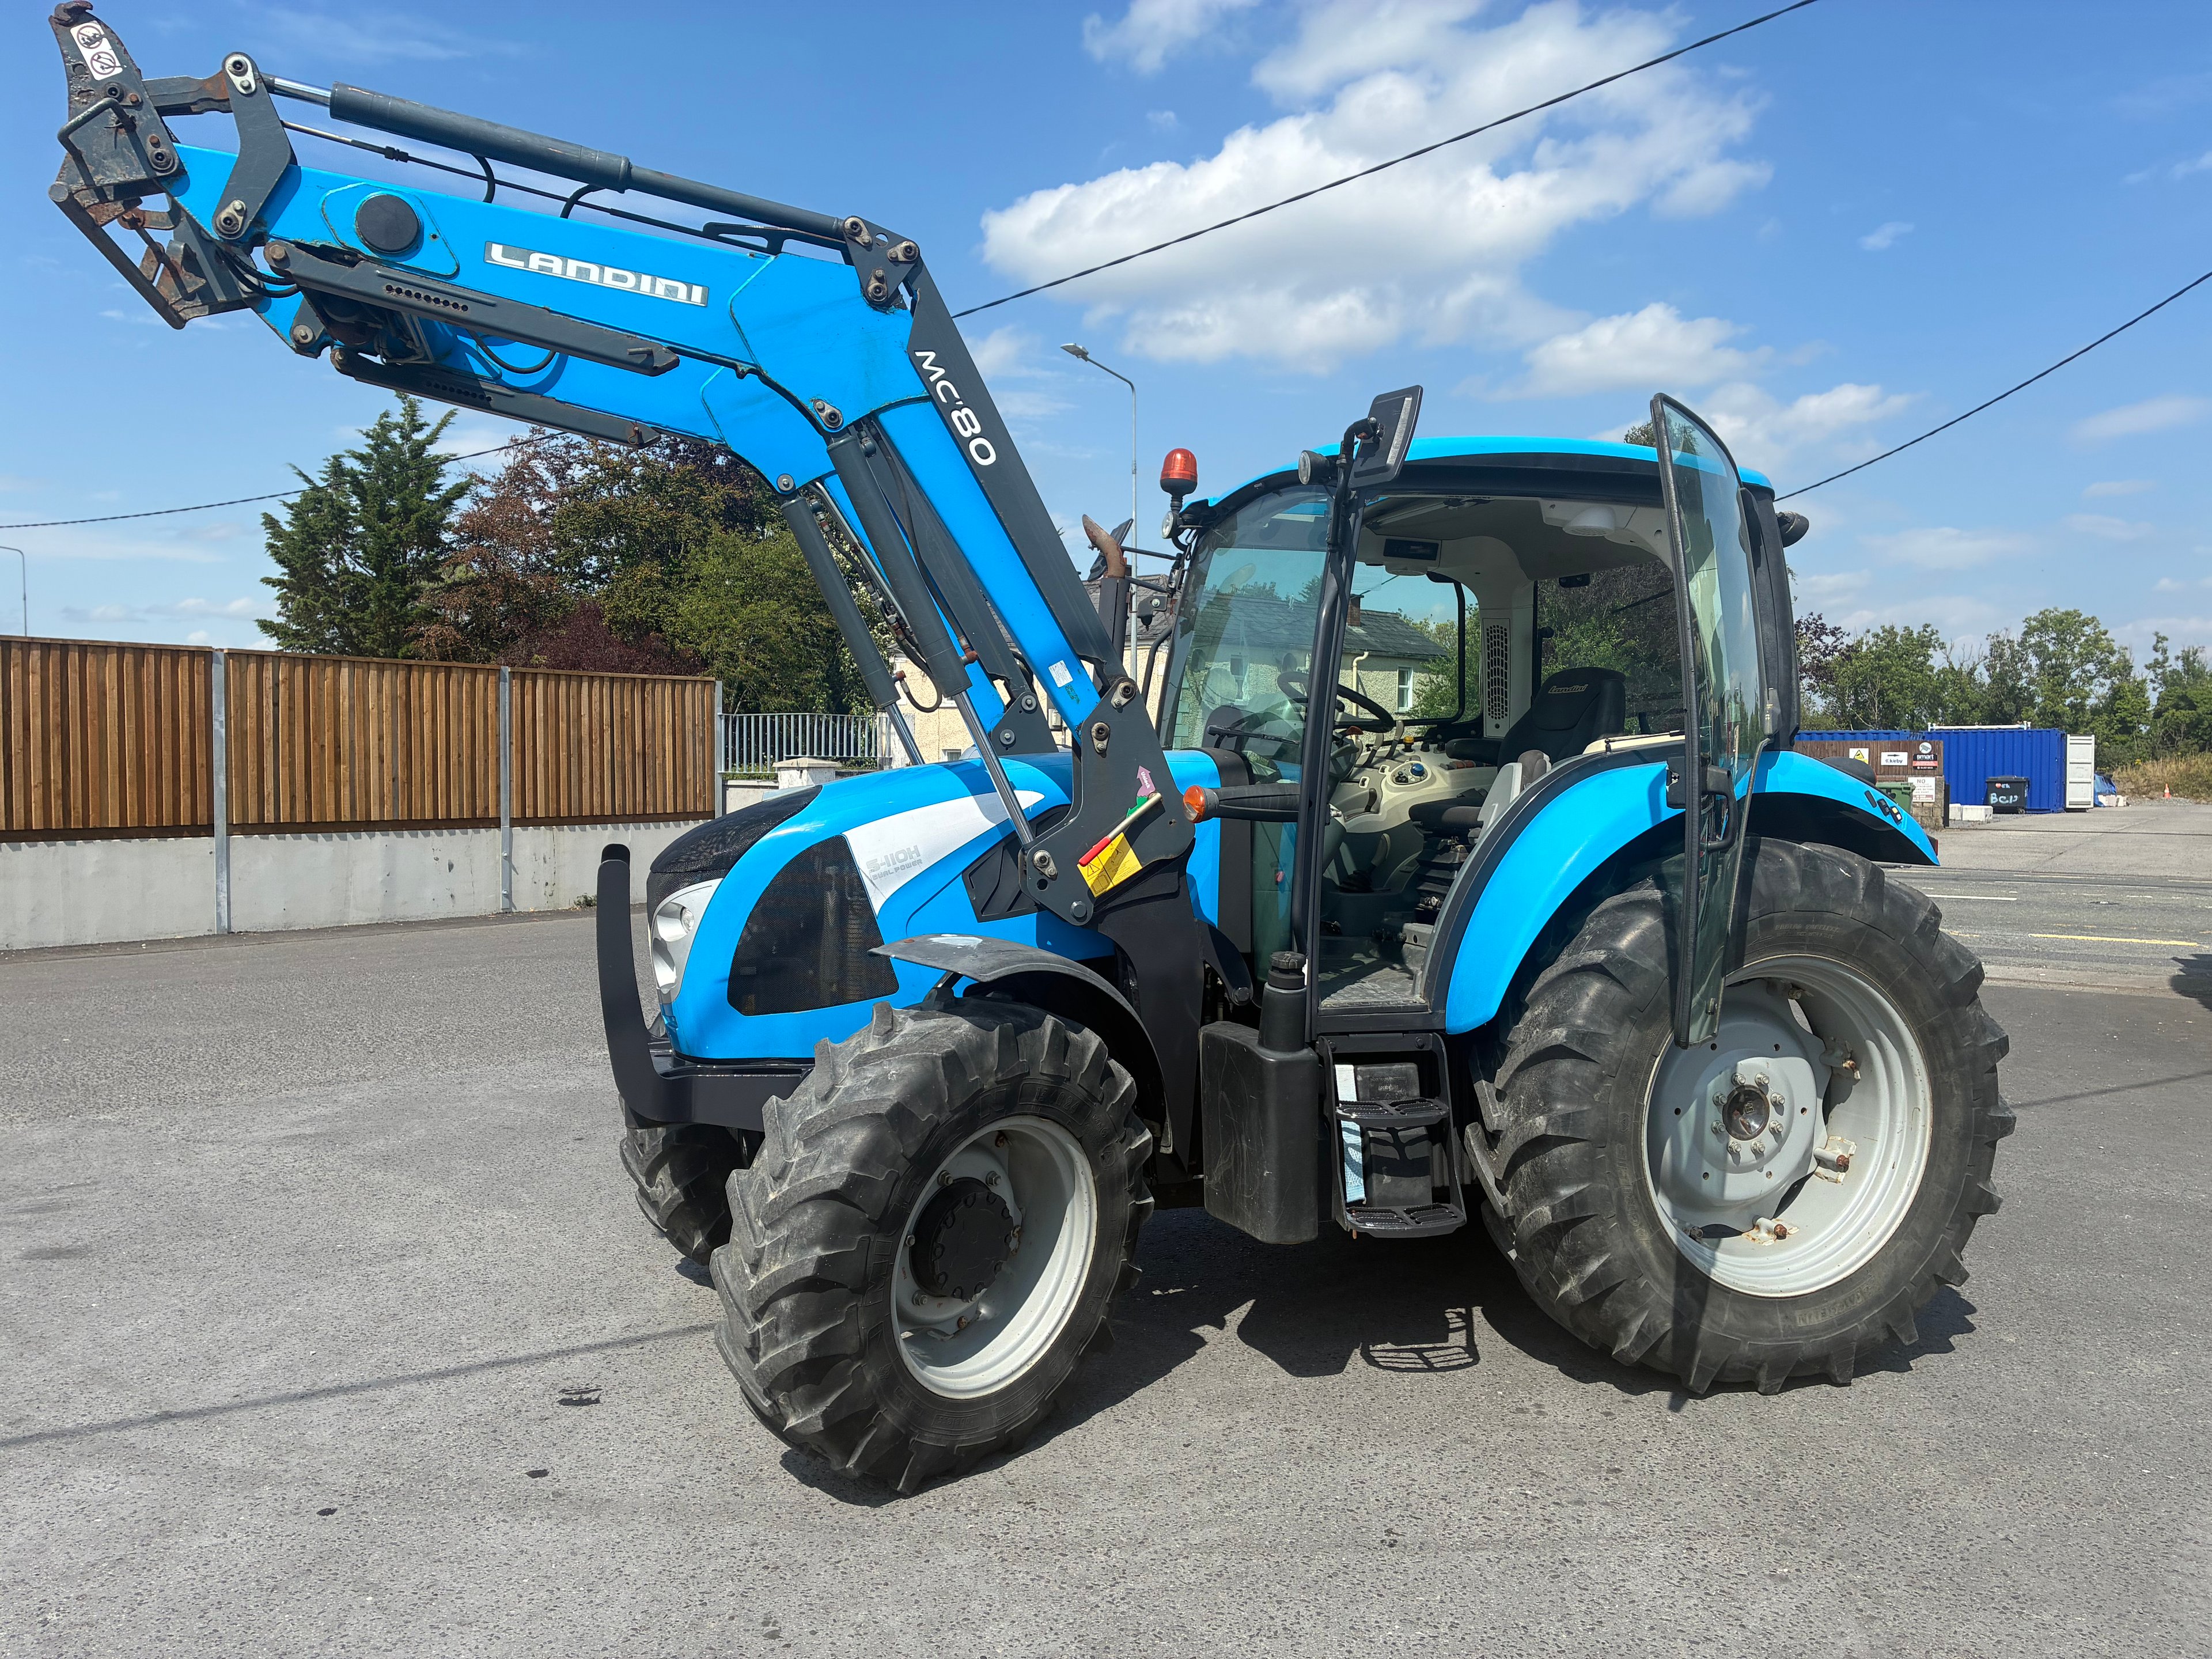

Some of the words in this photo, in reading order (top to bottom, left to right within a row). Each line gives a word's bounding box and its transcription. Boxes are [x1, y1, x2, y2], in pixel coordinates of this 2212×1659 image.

[490, 243, 703, 304] LANDINI
[1141, 771, 1151, 789] Unlock
[872, 869, 894, 880] DUAL
[894, 858, 923, 873] POWER
